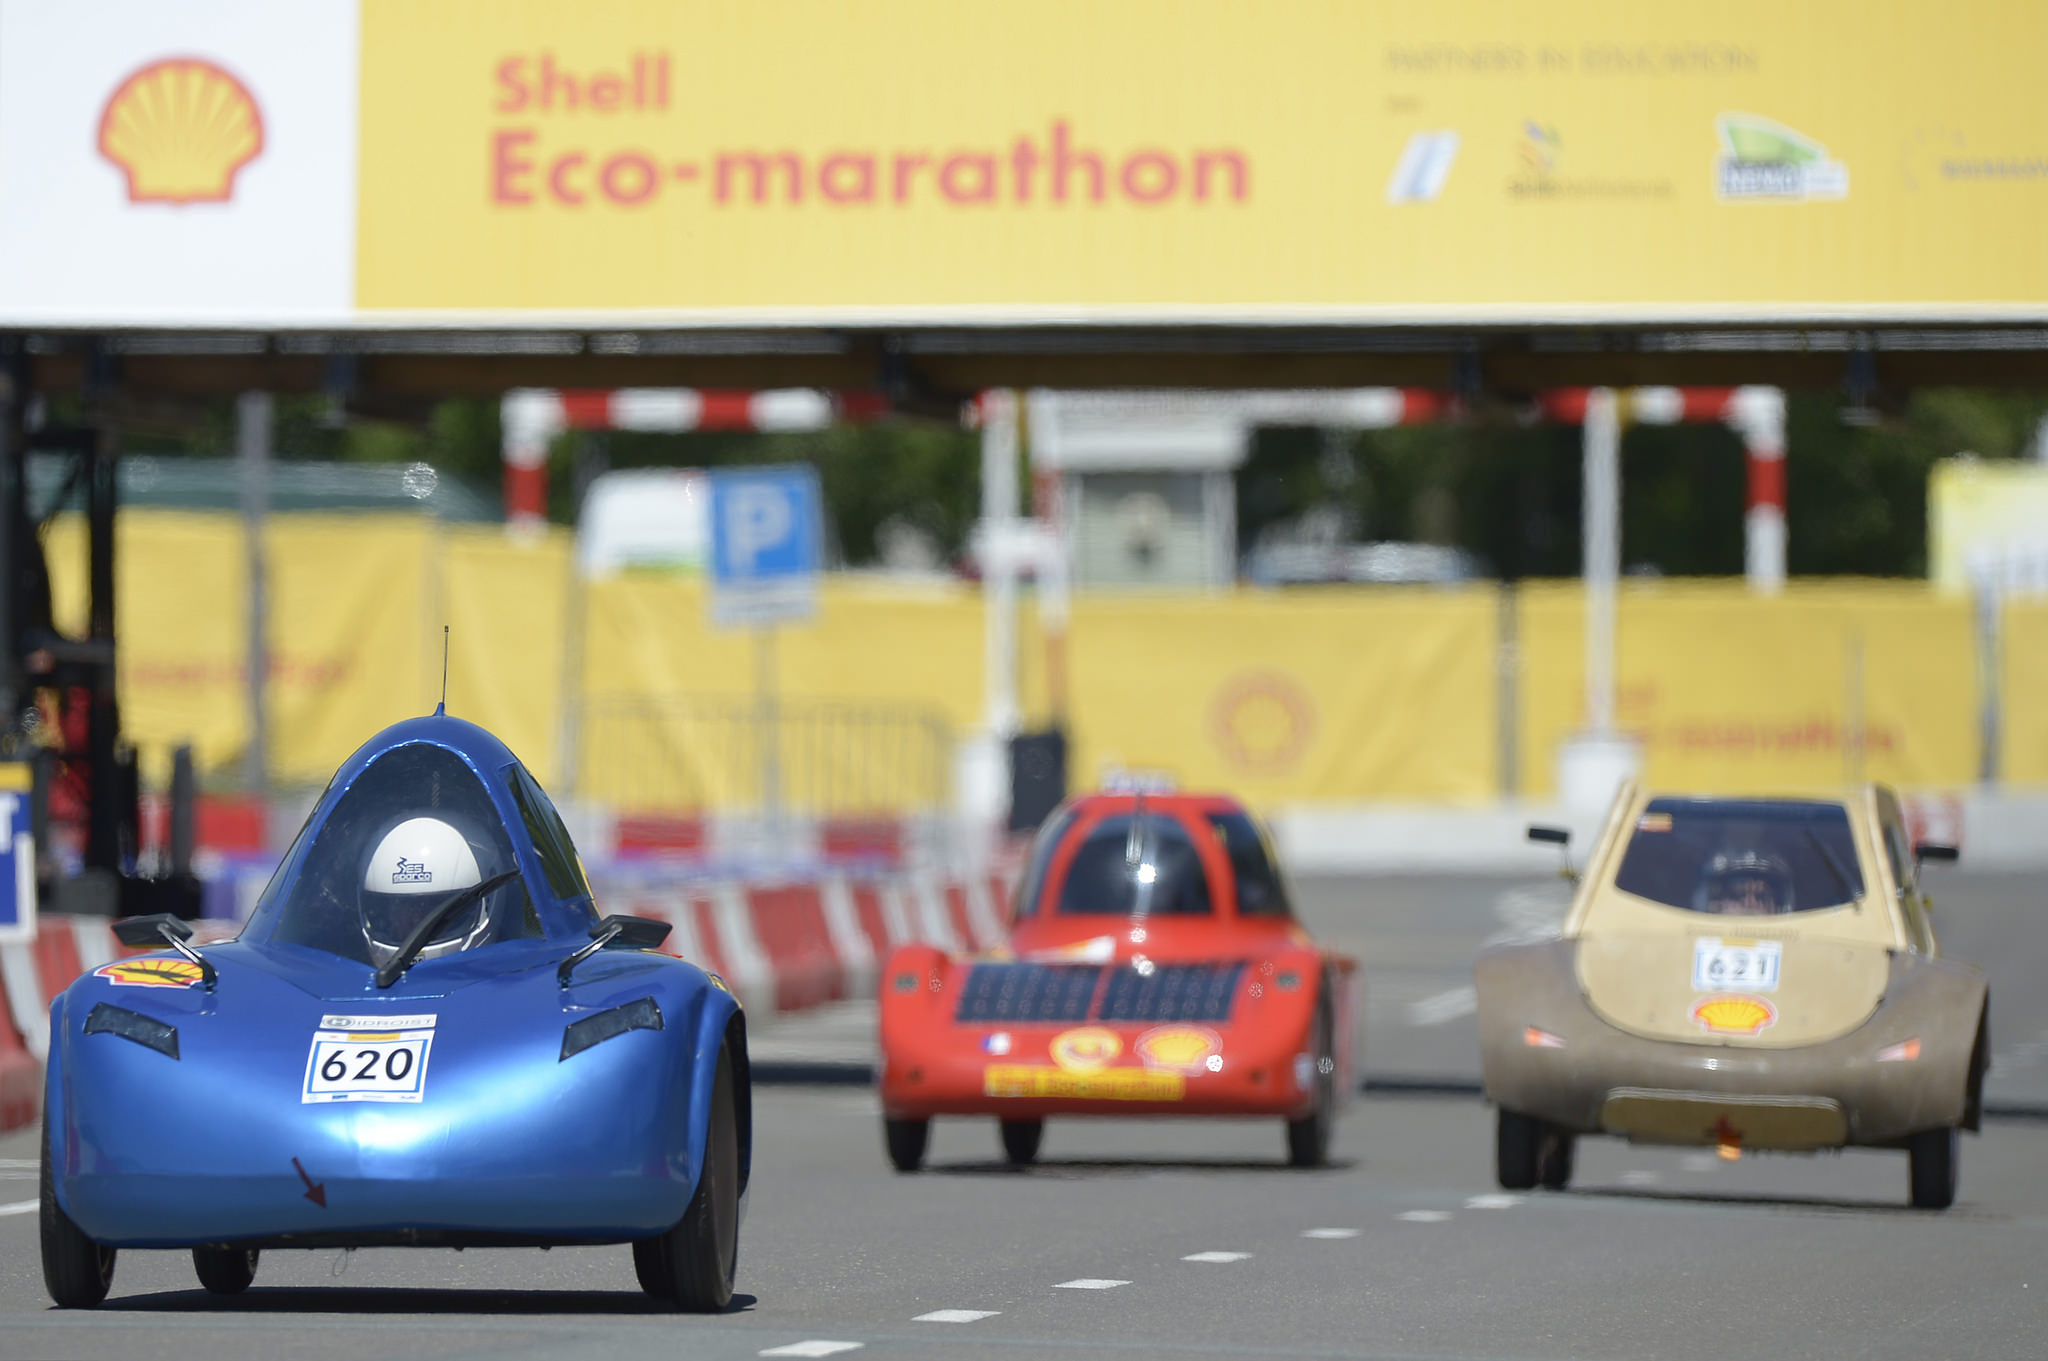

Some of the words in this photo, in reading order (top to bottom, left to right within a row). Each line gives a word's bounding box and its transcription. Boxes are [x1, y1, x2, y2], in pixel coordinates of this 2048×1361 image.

[494, 53, 671, 113] Shell
[490, 120, 1253, 207] Eco-marathon
[727, 482, 791, 570] P
[1707, 953, 1768, 980] 621
[321, 1048, 414, 1082] 620
